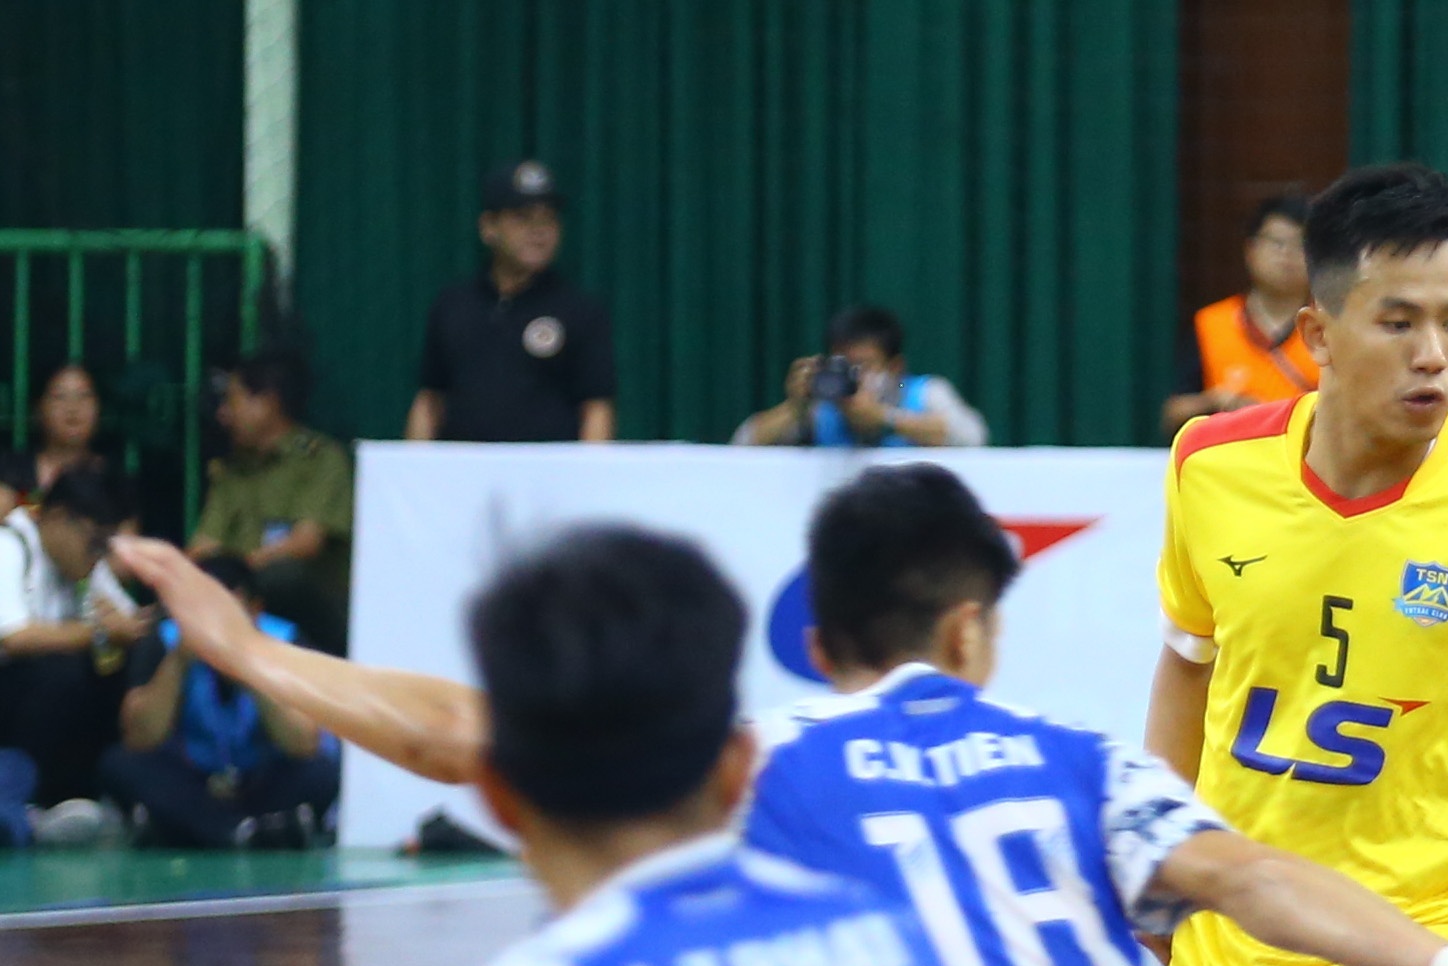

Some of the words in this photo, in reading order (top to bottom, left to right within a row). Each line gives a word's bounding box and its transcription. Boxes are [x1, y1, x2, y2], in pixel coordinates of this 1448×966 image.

[1416, 567, 1448, 585] TSN
[1314, 595, 1354, 689] 5
[1231, 686, 1394, 786] LS
